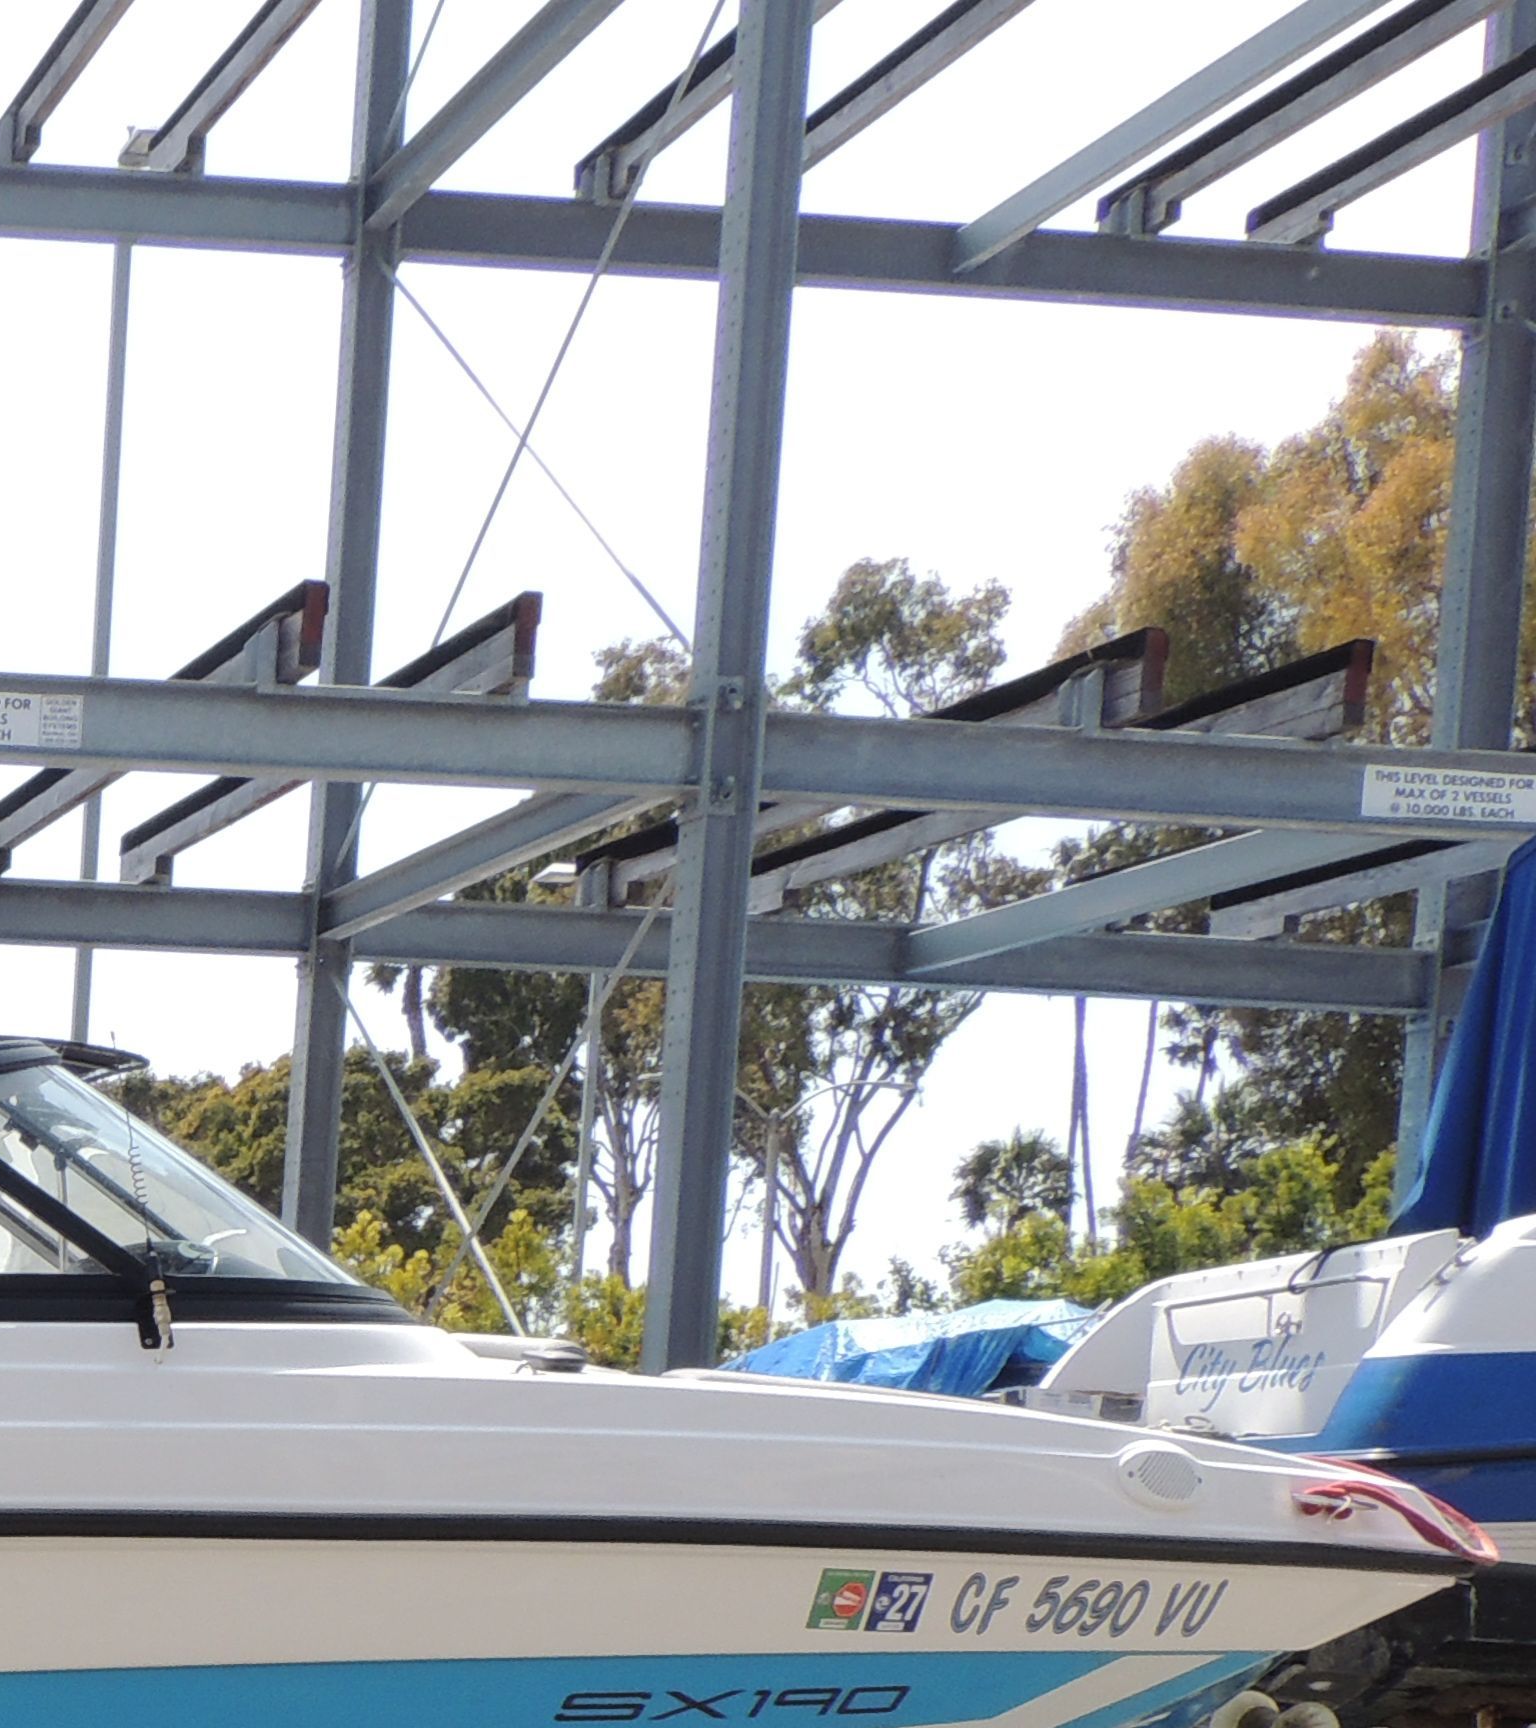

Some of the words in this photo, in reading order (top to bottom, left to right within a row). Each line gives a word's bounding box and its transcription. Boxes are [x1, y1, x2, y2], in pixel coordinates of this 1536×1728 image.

[5, 697, 31, 710] FOR
[1375, 770, 1401, 783] THIS
[1404, 773, 1439, 785] LEVEL
[1443, 774, 1506, 788] DESIGNED
[1509, 778, 1535, 790] FOR
[1394, 787, 1426, 799] MAX
[1430, 789, 1448, 801] OF
[1452, 791, 1459, 801] 2
[1464, 791, 1512, 805] VESSELS
[1481, 806, 1515, 819] EACH
[1176, 1343, 1237, 1413] City
[1239, 1334, 1326, 1393] Blues
[885, 1583, 928, 1621] 27
[950, 1571, 1020, 1635] CF
[1025, 1575, 1151, 1637] 5690
[1154, 1579, 1229, 1637] VU
[553, 1685, 911, 1721] SX190
